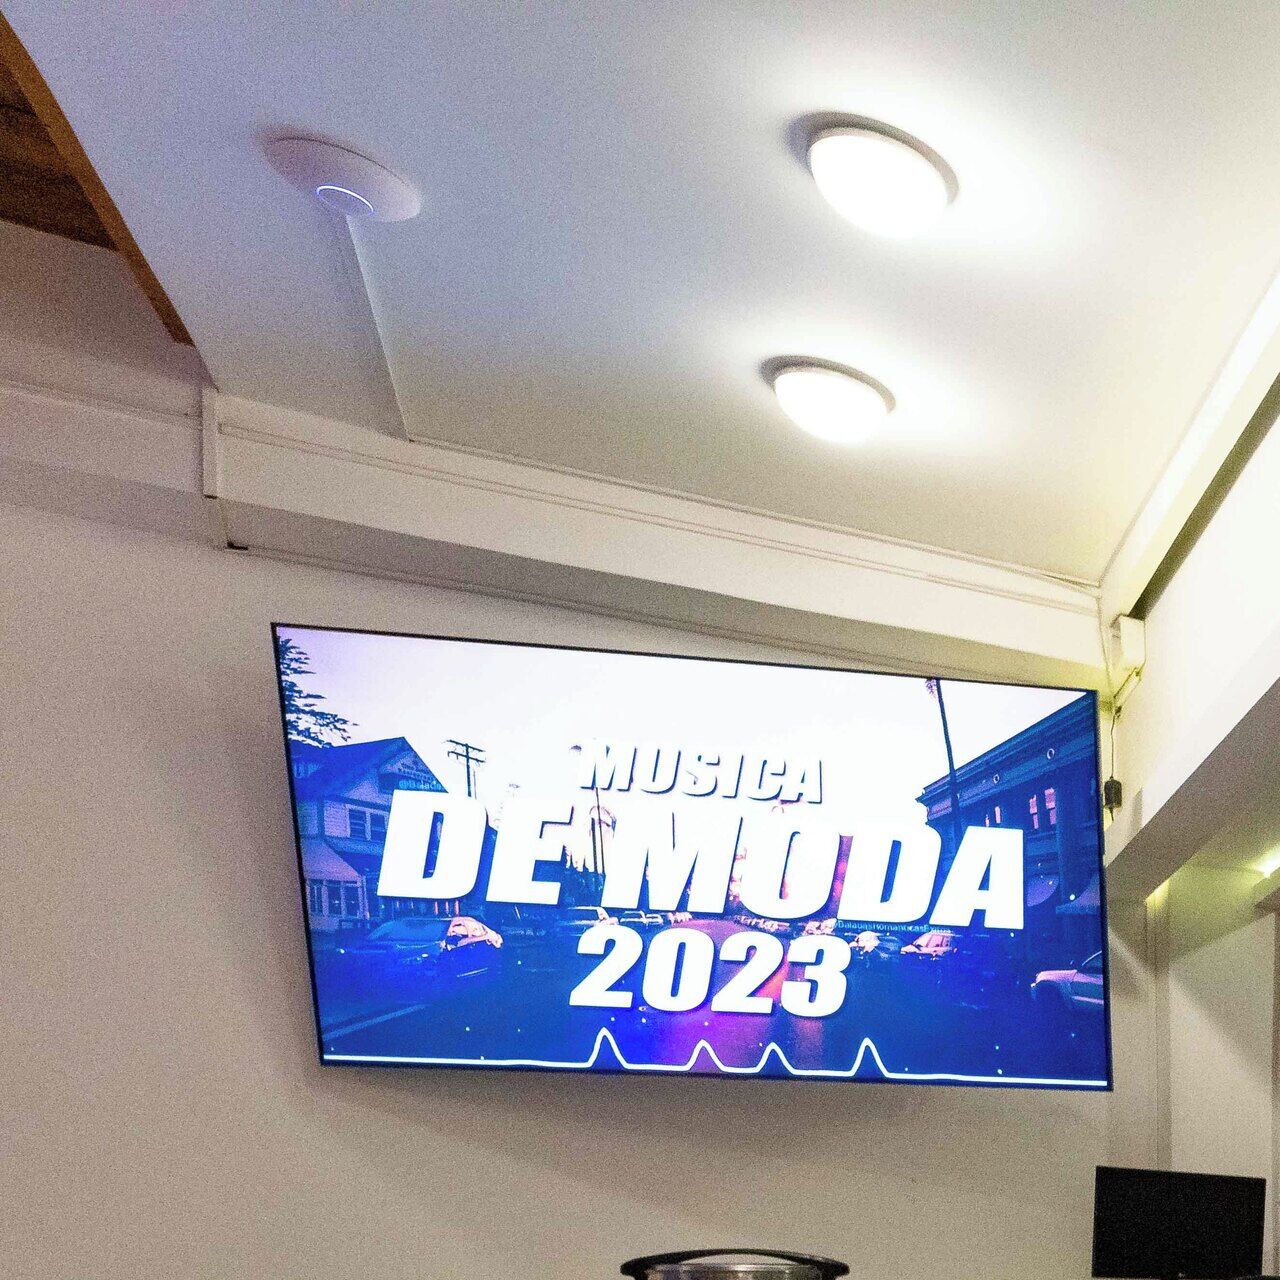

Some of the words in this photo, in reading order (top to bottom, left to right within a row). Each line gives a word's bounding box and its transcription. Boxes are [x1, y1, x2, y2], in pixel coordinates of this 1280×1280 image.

[579, 744, 822, 804] MUSICA
[378, 790, 574, 905] DE
[600, 804, 1024, 930] MODA
[568, 925, 852, 1018] 2023
